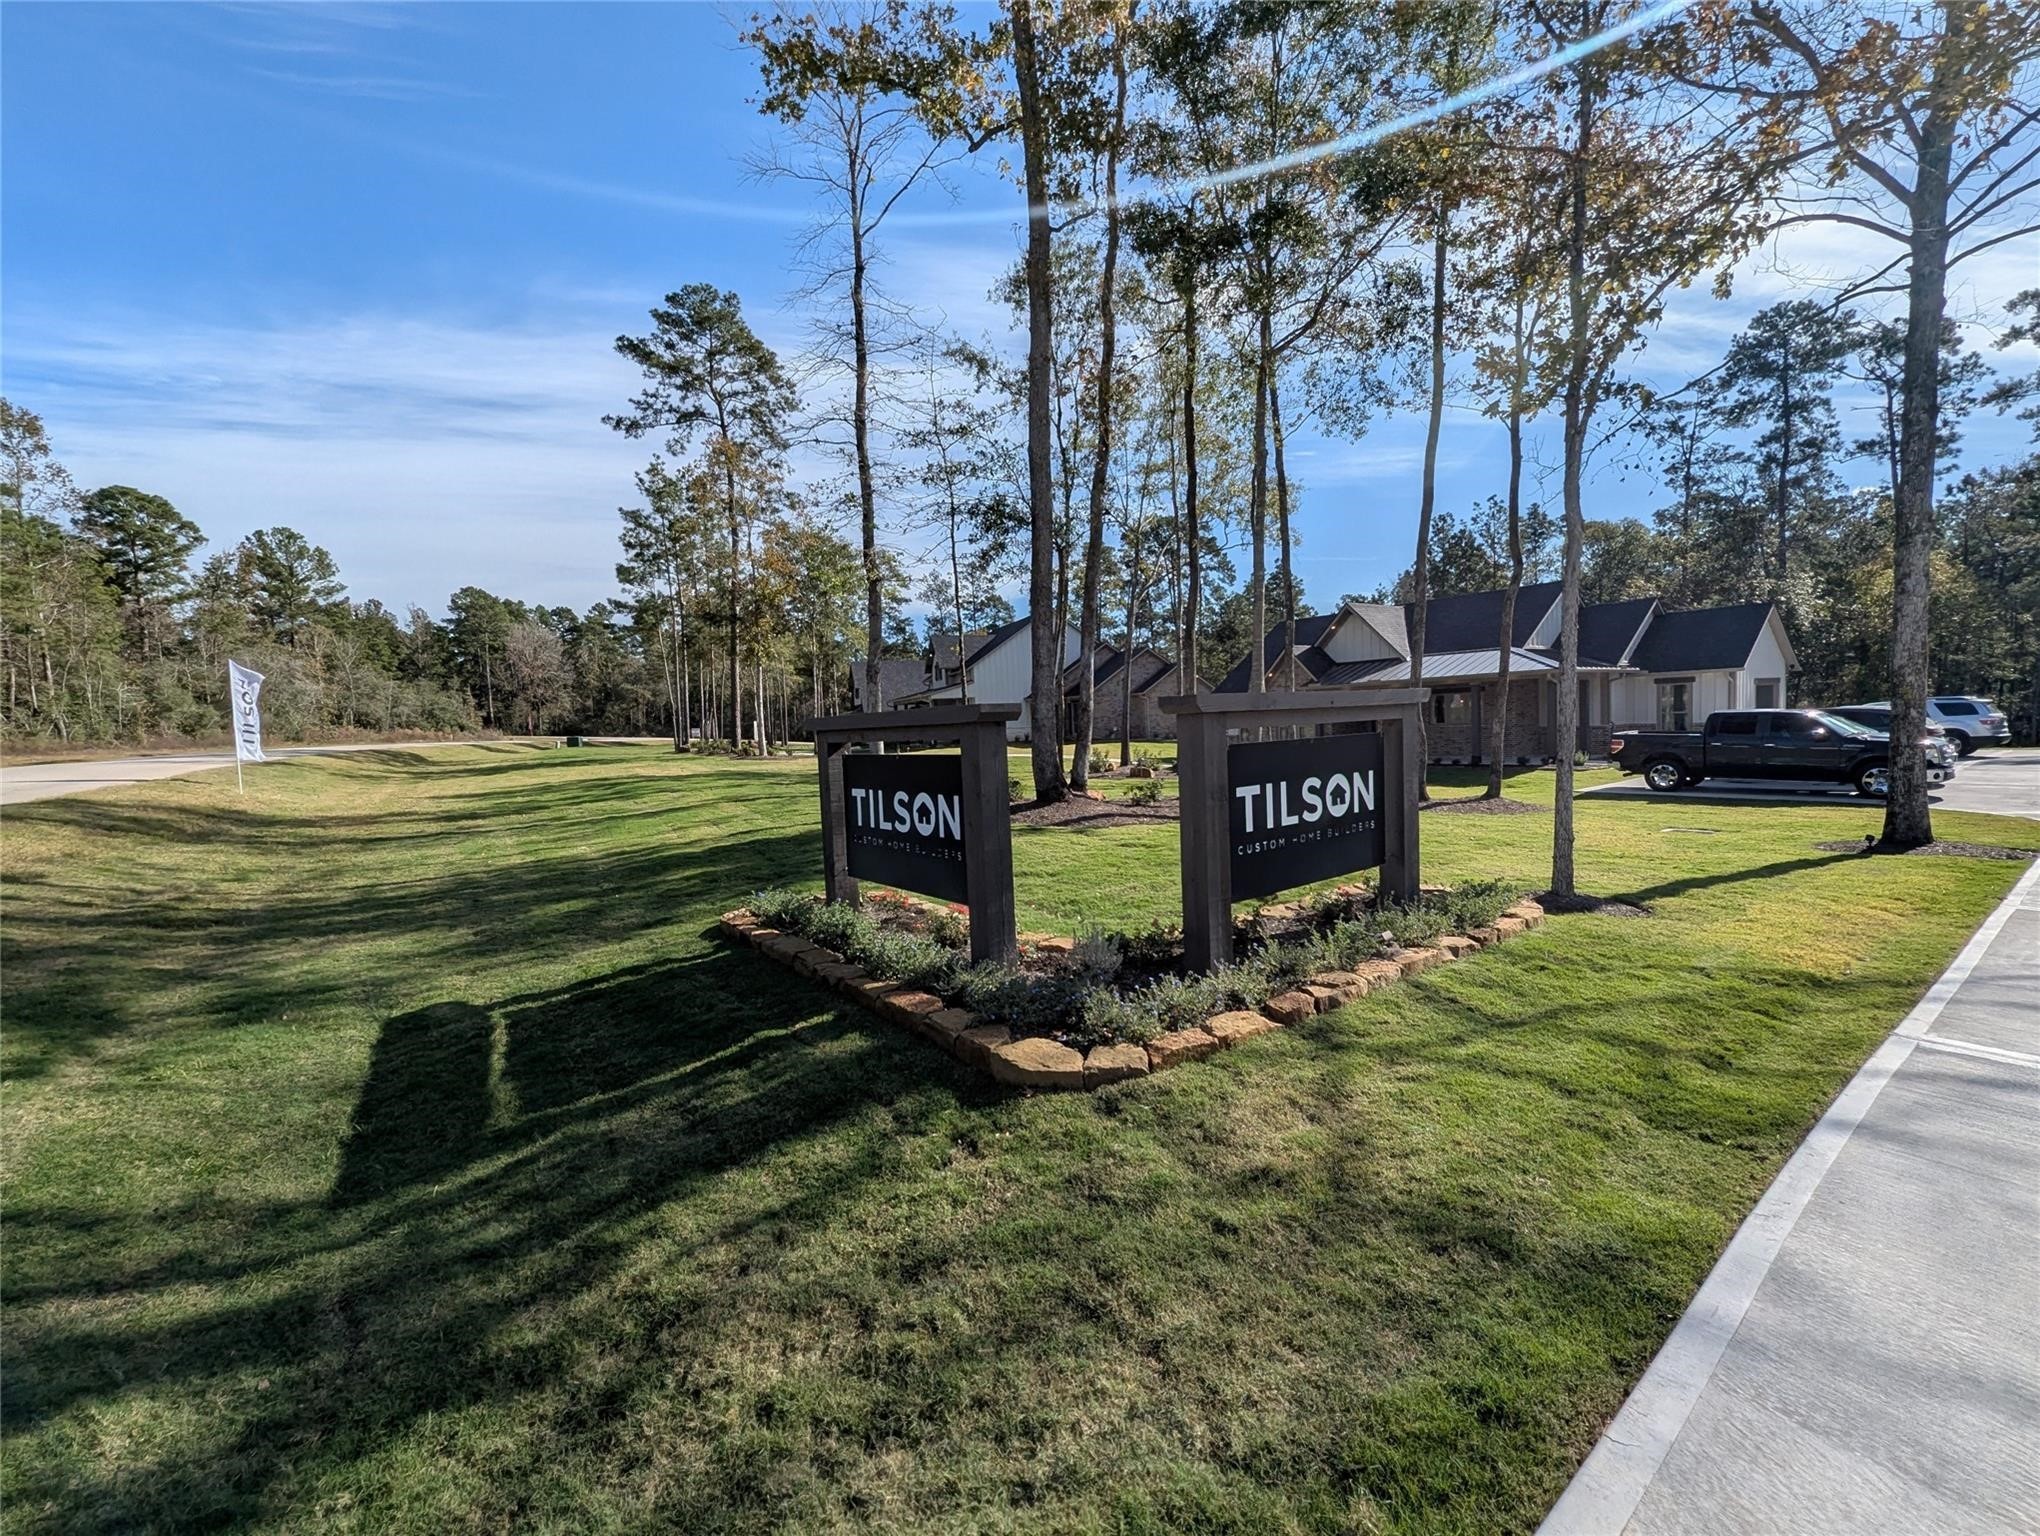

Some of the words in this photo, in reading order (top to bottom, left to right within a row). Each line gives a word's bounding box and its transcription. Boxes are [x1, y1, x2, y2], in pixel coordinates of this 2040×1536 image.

[851, 788, 961, 840] TILSON
[1236, 770, 1375, 833] TILSON
[1237, 838, 1285, 855] CUSTOM
